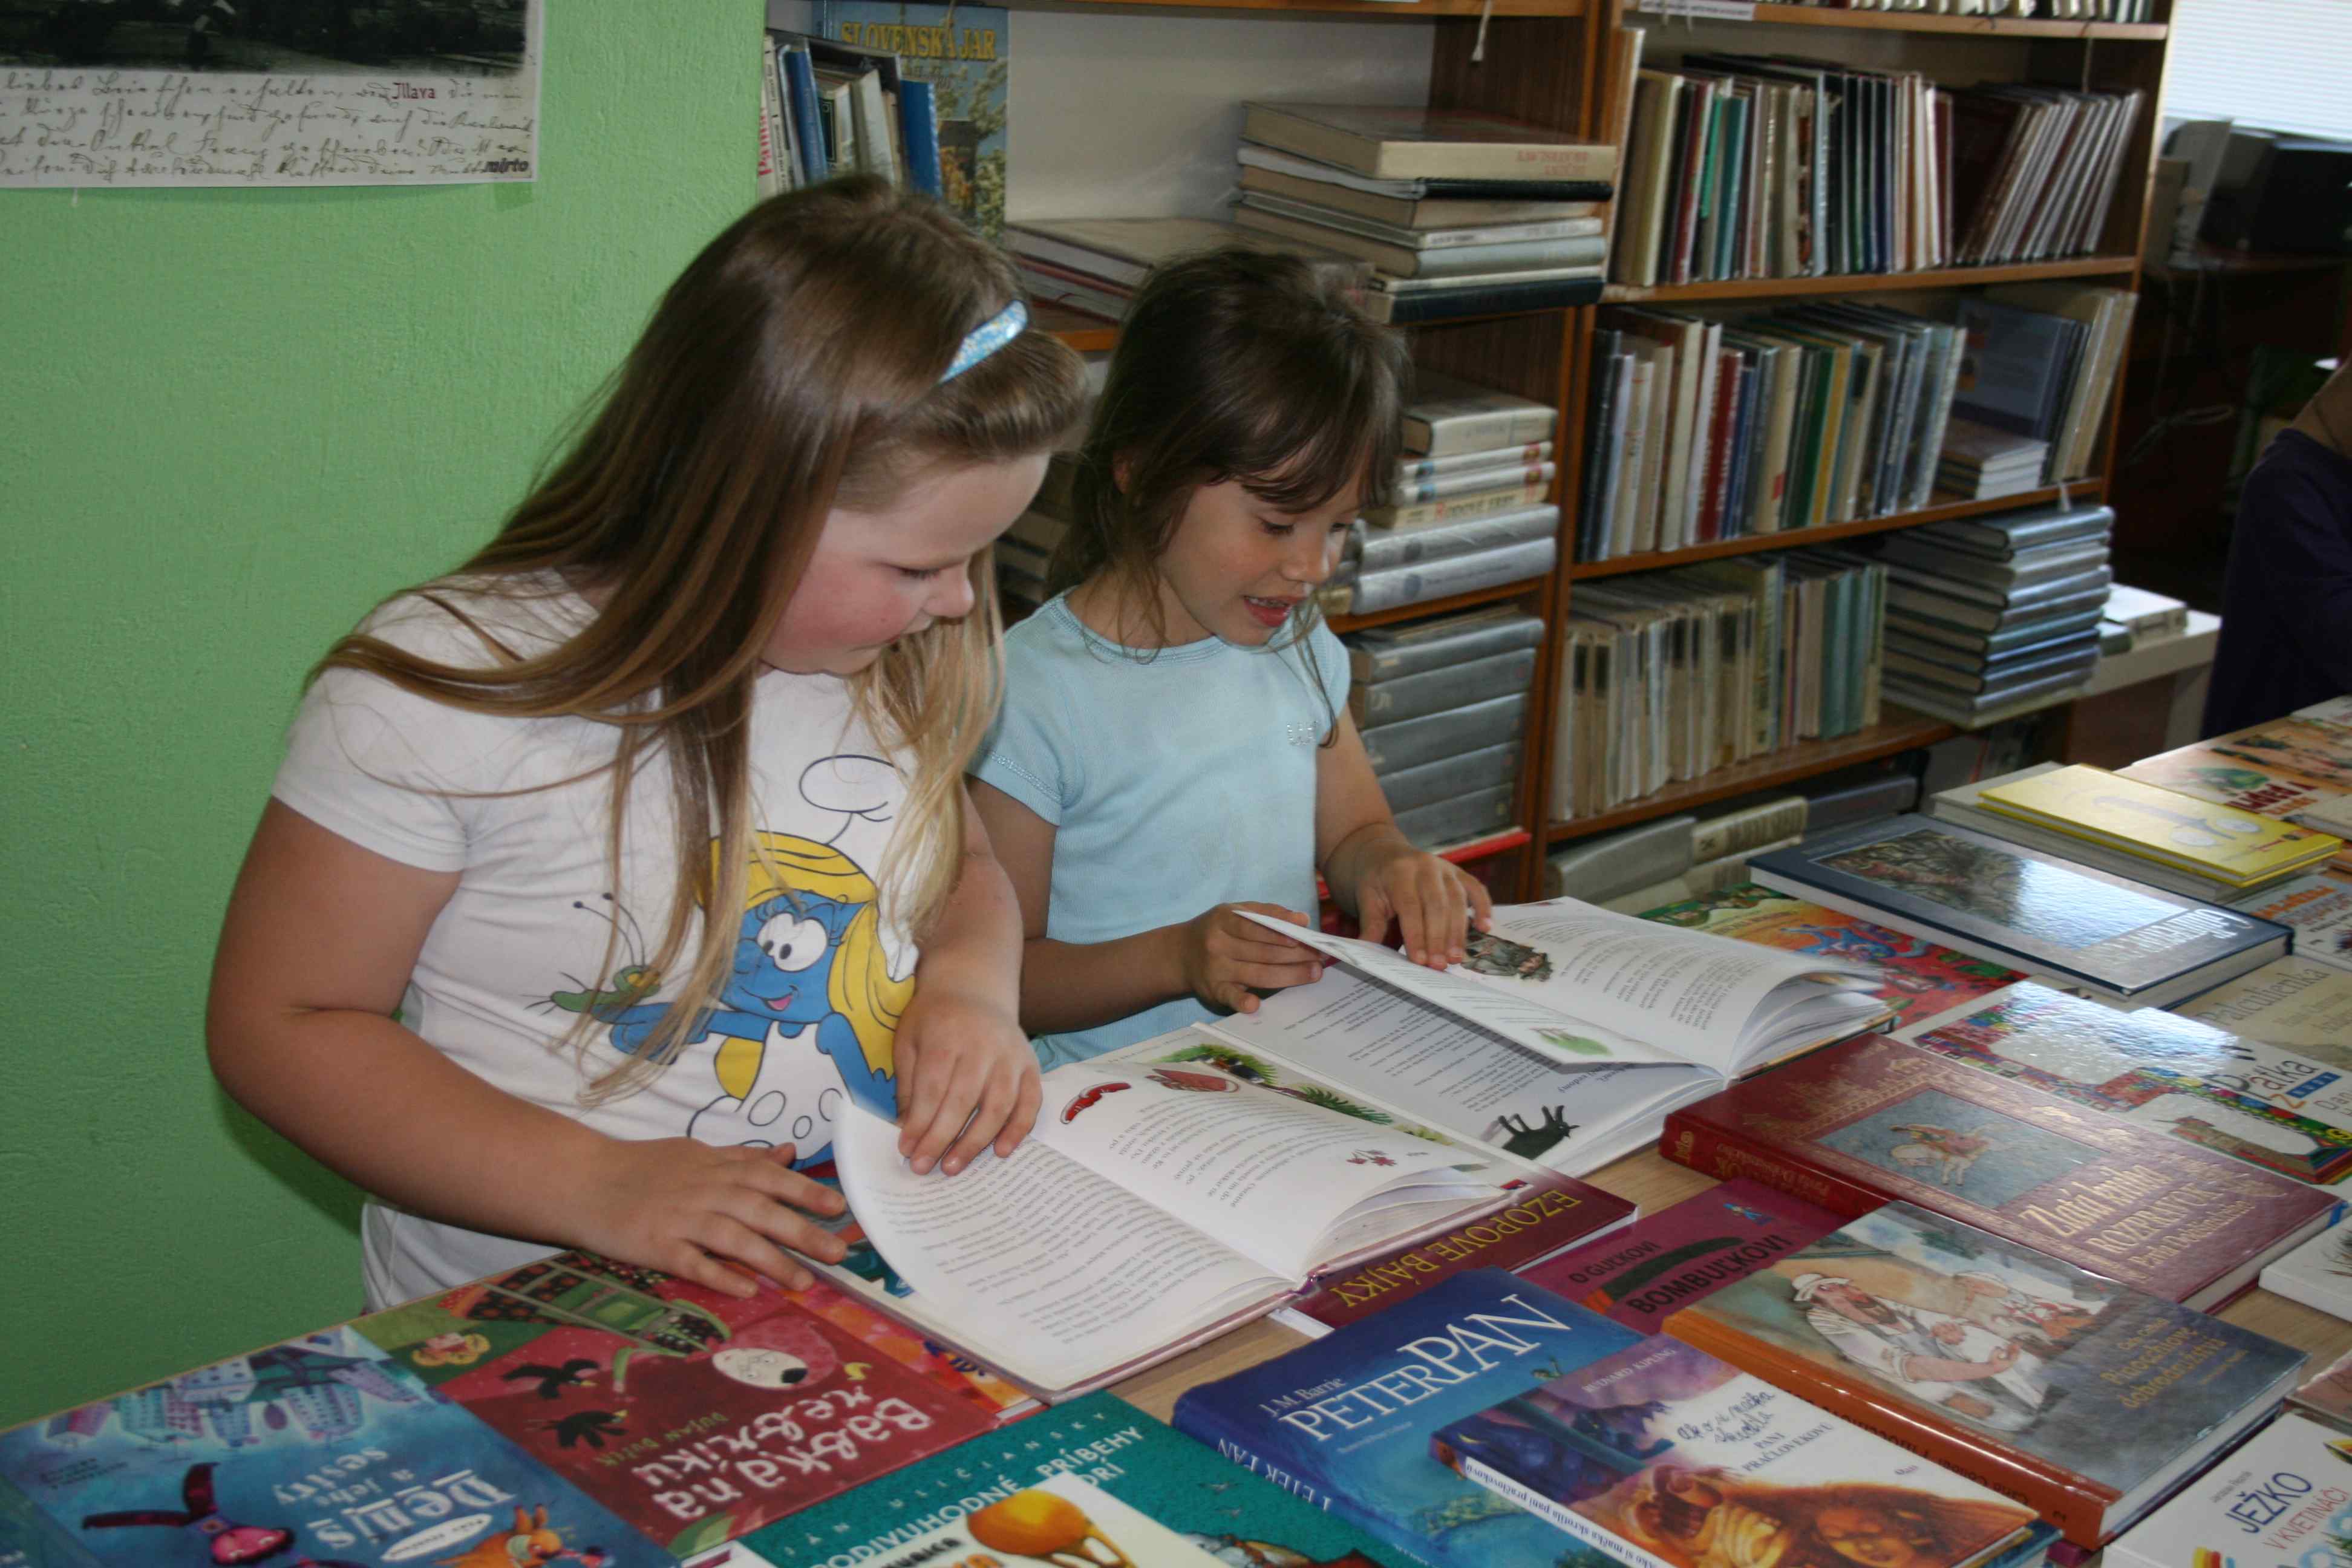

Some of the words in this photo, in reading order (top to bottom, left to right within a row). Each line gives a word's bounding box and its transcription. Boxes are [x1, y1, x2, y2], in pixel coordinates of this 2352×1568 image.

[958, 29, 997, 60] JAR
[2195, 968, 2330, 1026] Palculienka
[2201, 1060, 2319, 1100] Pätka
[1445, 1189, 1584, 1263] EZOPOVE
[1328, 1239, 1440, 1308] BÁJKY
[1627, 1233, 1794, 1315] BOMBUĽKOVI
[1278, 1363, 1445, 1442] PETER
[1396, 1294, 1571, 1384] PAN
[1635, 1348, 1677, 1372] KIPLING
[1293, 1377, 1347, 1400] Barrie
[734, 1397, 933, 1490] Babka
[1035, 1424, 1145, 1479] PRÍBEHY
[271, 1446, 389, 1506] sestry
[651, 1478, 742, 1520] na
[2224, 1471, 2313, 1534] JEŽKO
[1552, 1510, 1590, 1537] skrotila
[1592, 1530, 1623, 1555] mačka
